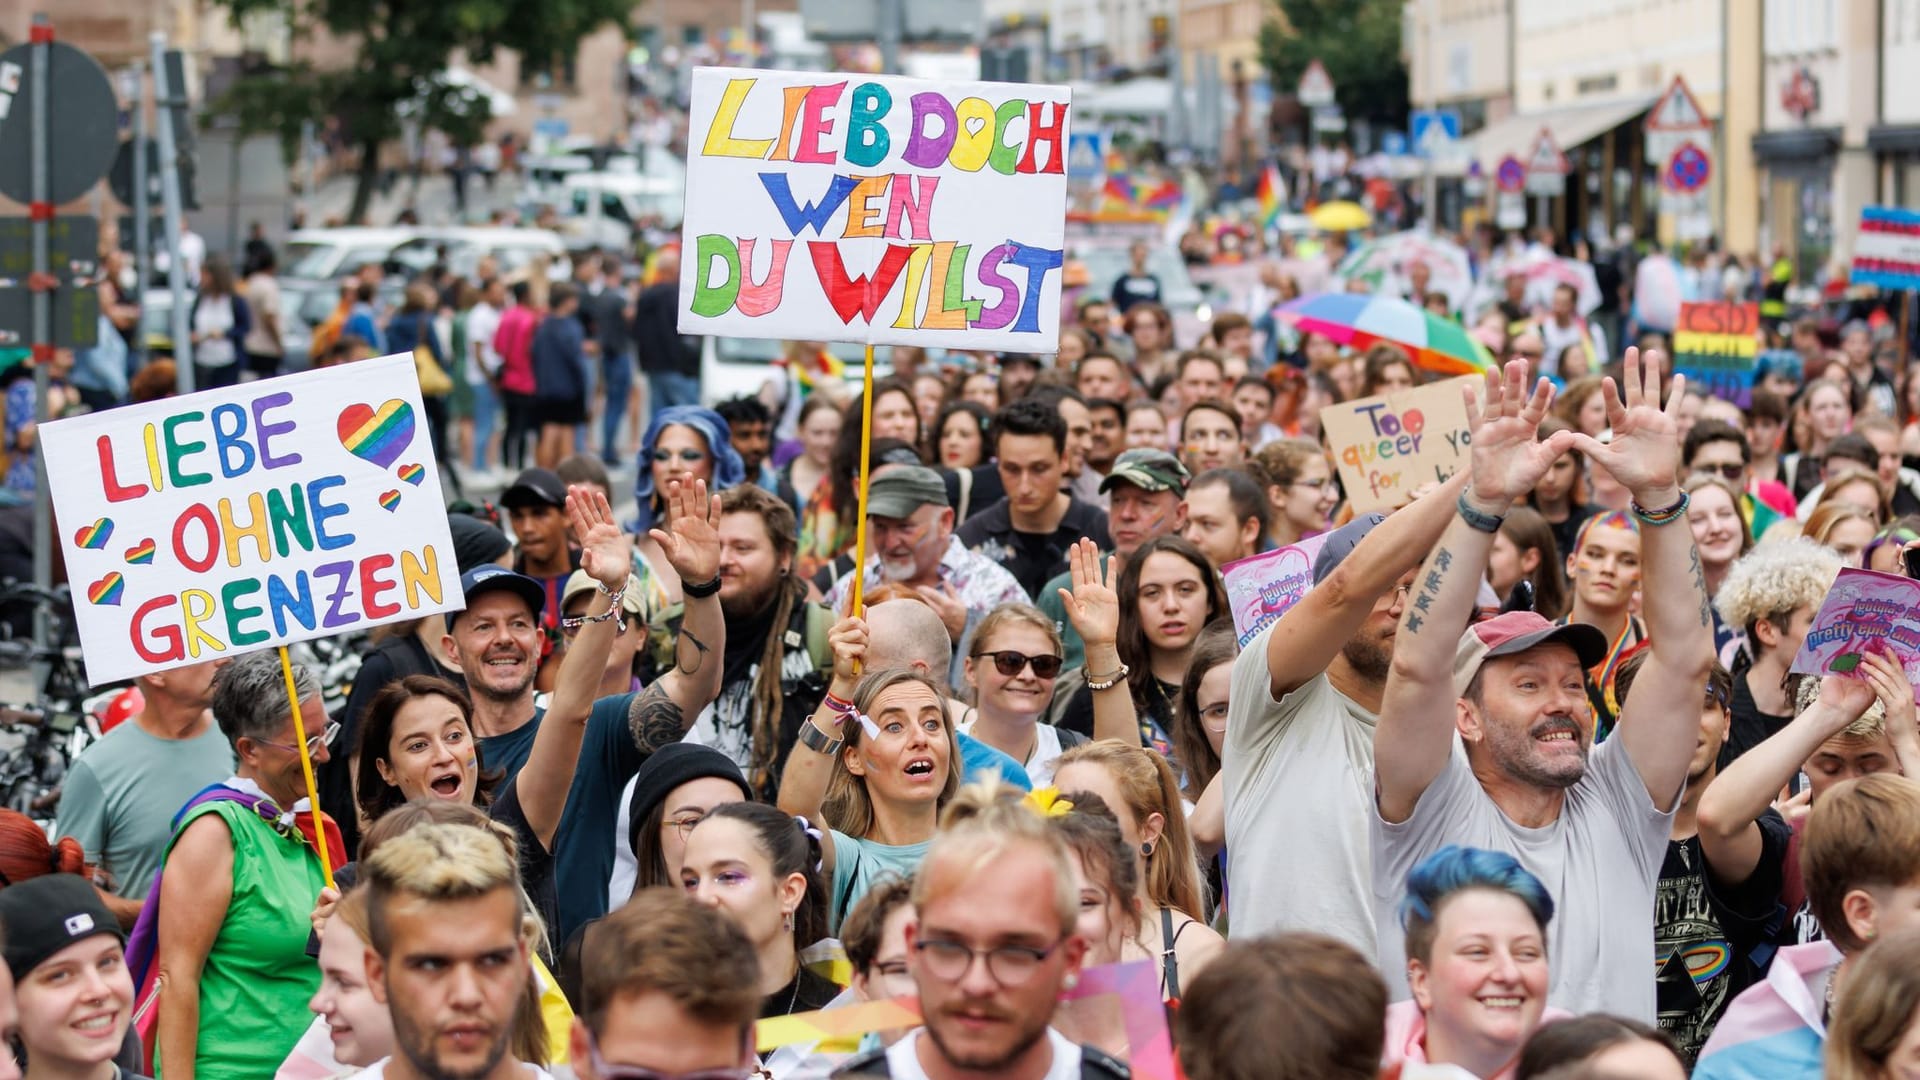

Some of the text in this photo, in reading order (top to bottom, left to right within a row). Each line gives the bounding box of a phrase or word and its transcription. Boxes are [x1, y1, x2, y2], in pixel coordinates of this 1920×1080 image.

[702, 78, 1070, 175] LIEB DOCH
[758, 172, 941, 240] WEN
[690, 234, 1063, 333] DU WILLST
[1686, 304, 1747, 334] CSD
[96, 391, 302, 503] LIEBE
[1342, 433, 1423, 478] queer
[1369, 470, 1401, 499] for
[172, 475, 356, 574] OHNE
[130, 544, 443, 663] GRENZEN
[1806, 621, 1855, 651] pretty
[1854, 618, 1893, 640] epic
[1664, 923, 1693, 936] 1972
